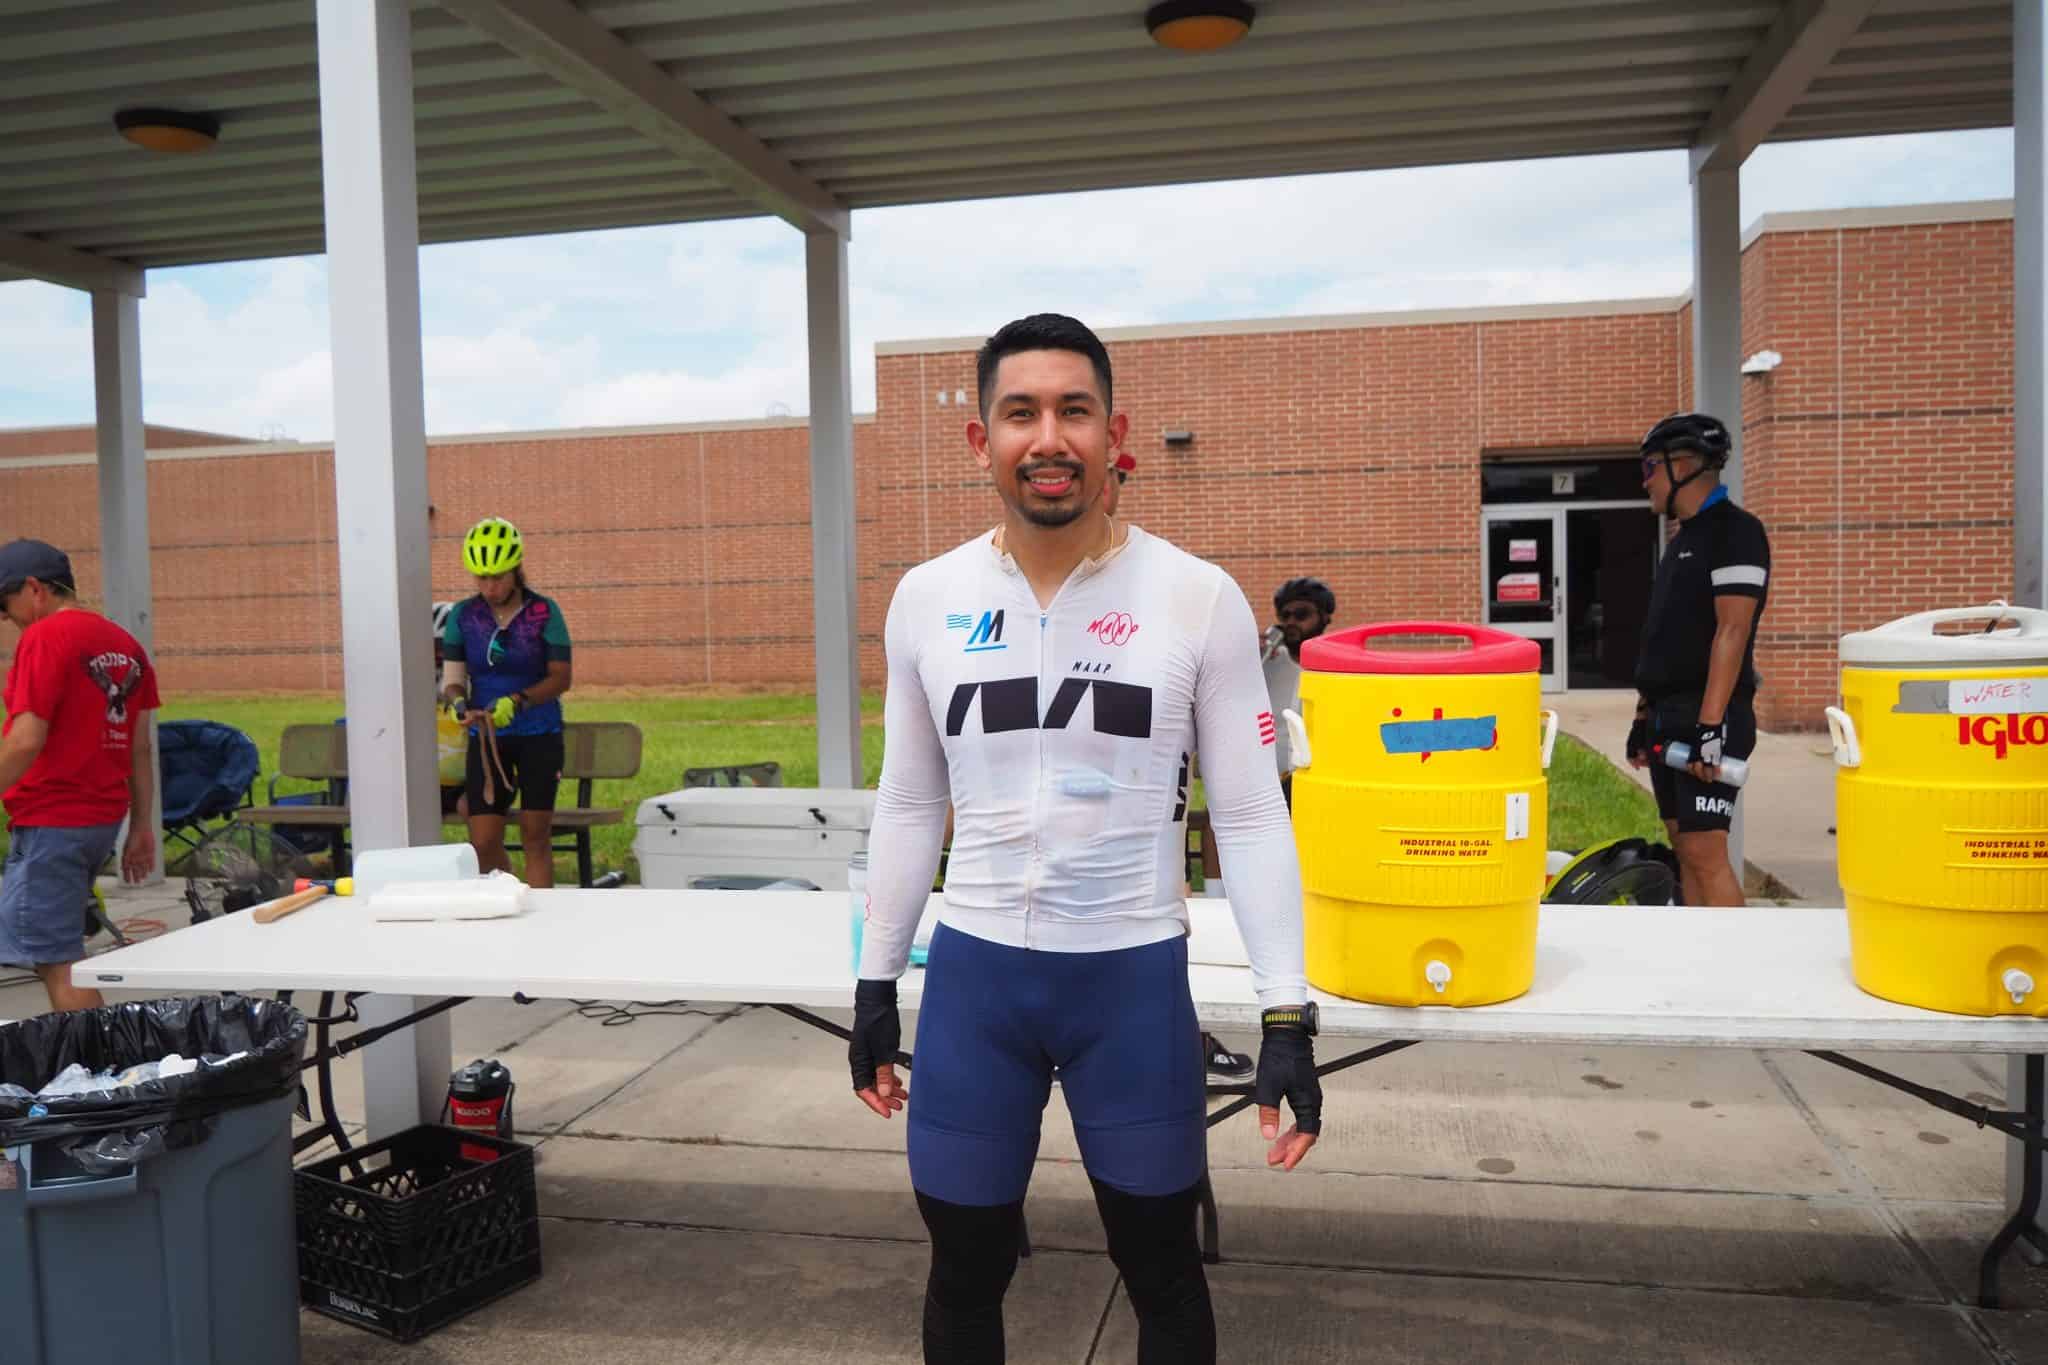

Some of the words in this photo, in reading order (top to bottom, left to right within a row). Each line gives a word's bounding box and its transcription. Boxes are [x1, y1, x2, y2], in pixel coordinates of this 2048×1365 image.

[1558, 476, 1567, 489] 7
[1400, 839, 1456, 847] INDUSTRIAL
[1965, 840, 2031, 848] INDUSTRIAL
[1406, 849, 1455, 857] DRINKING
[1459, 849, 1489, 857] WATER
[1971, 851, 2029, 859] DRINKING
